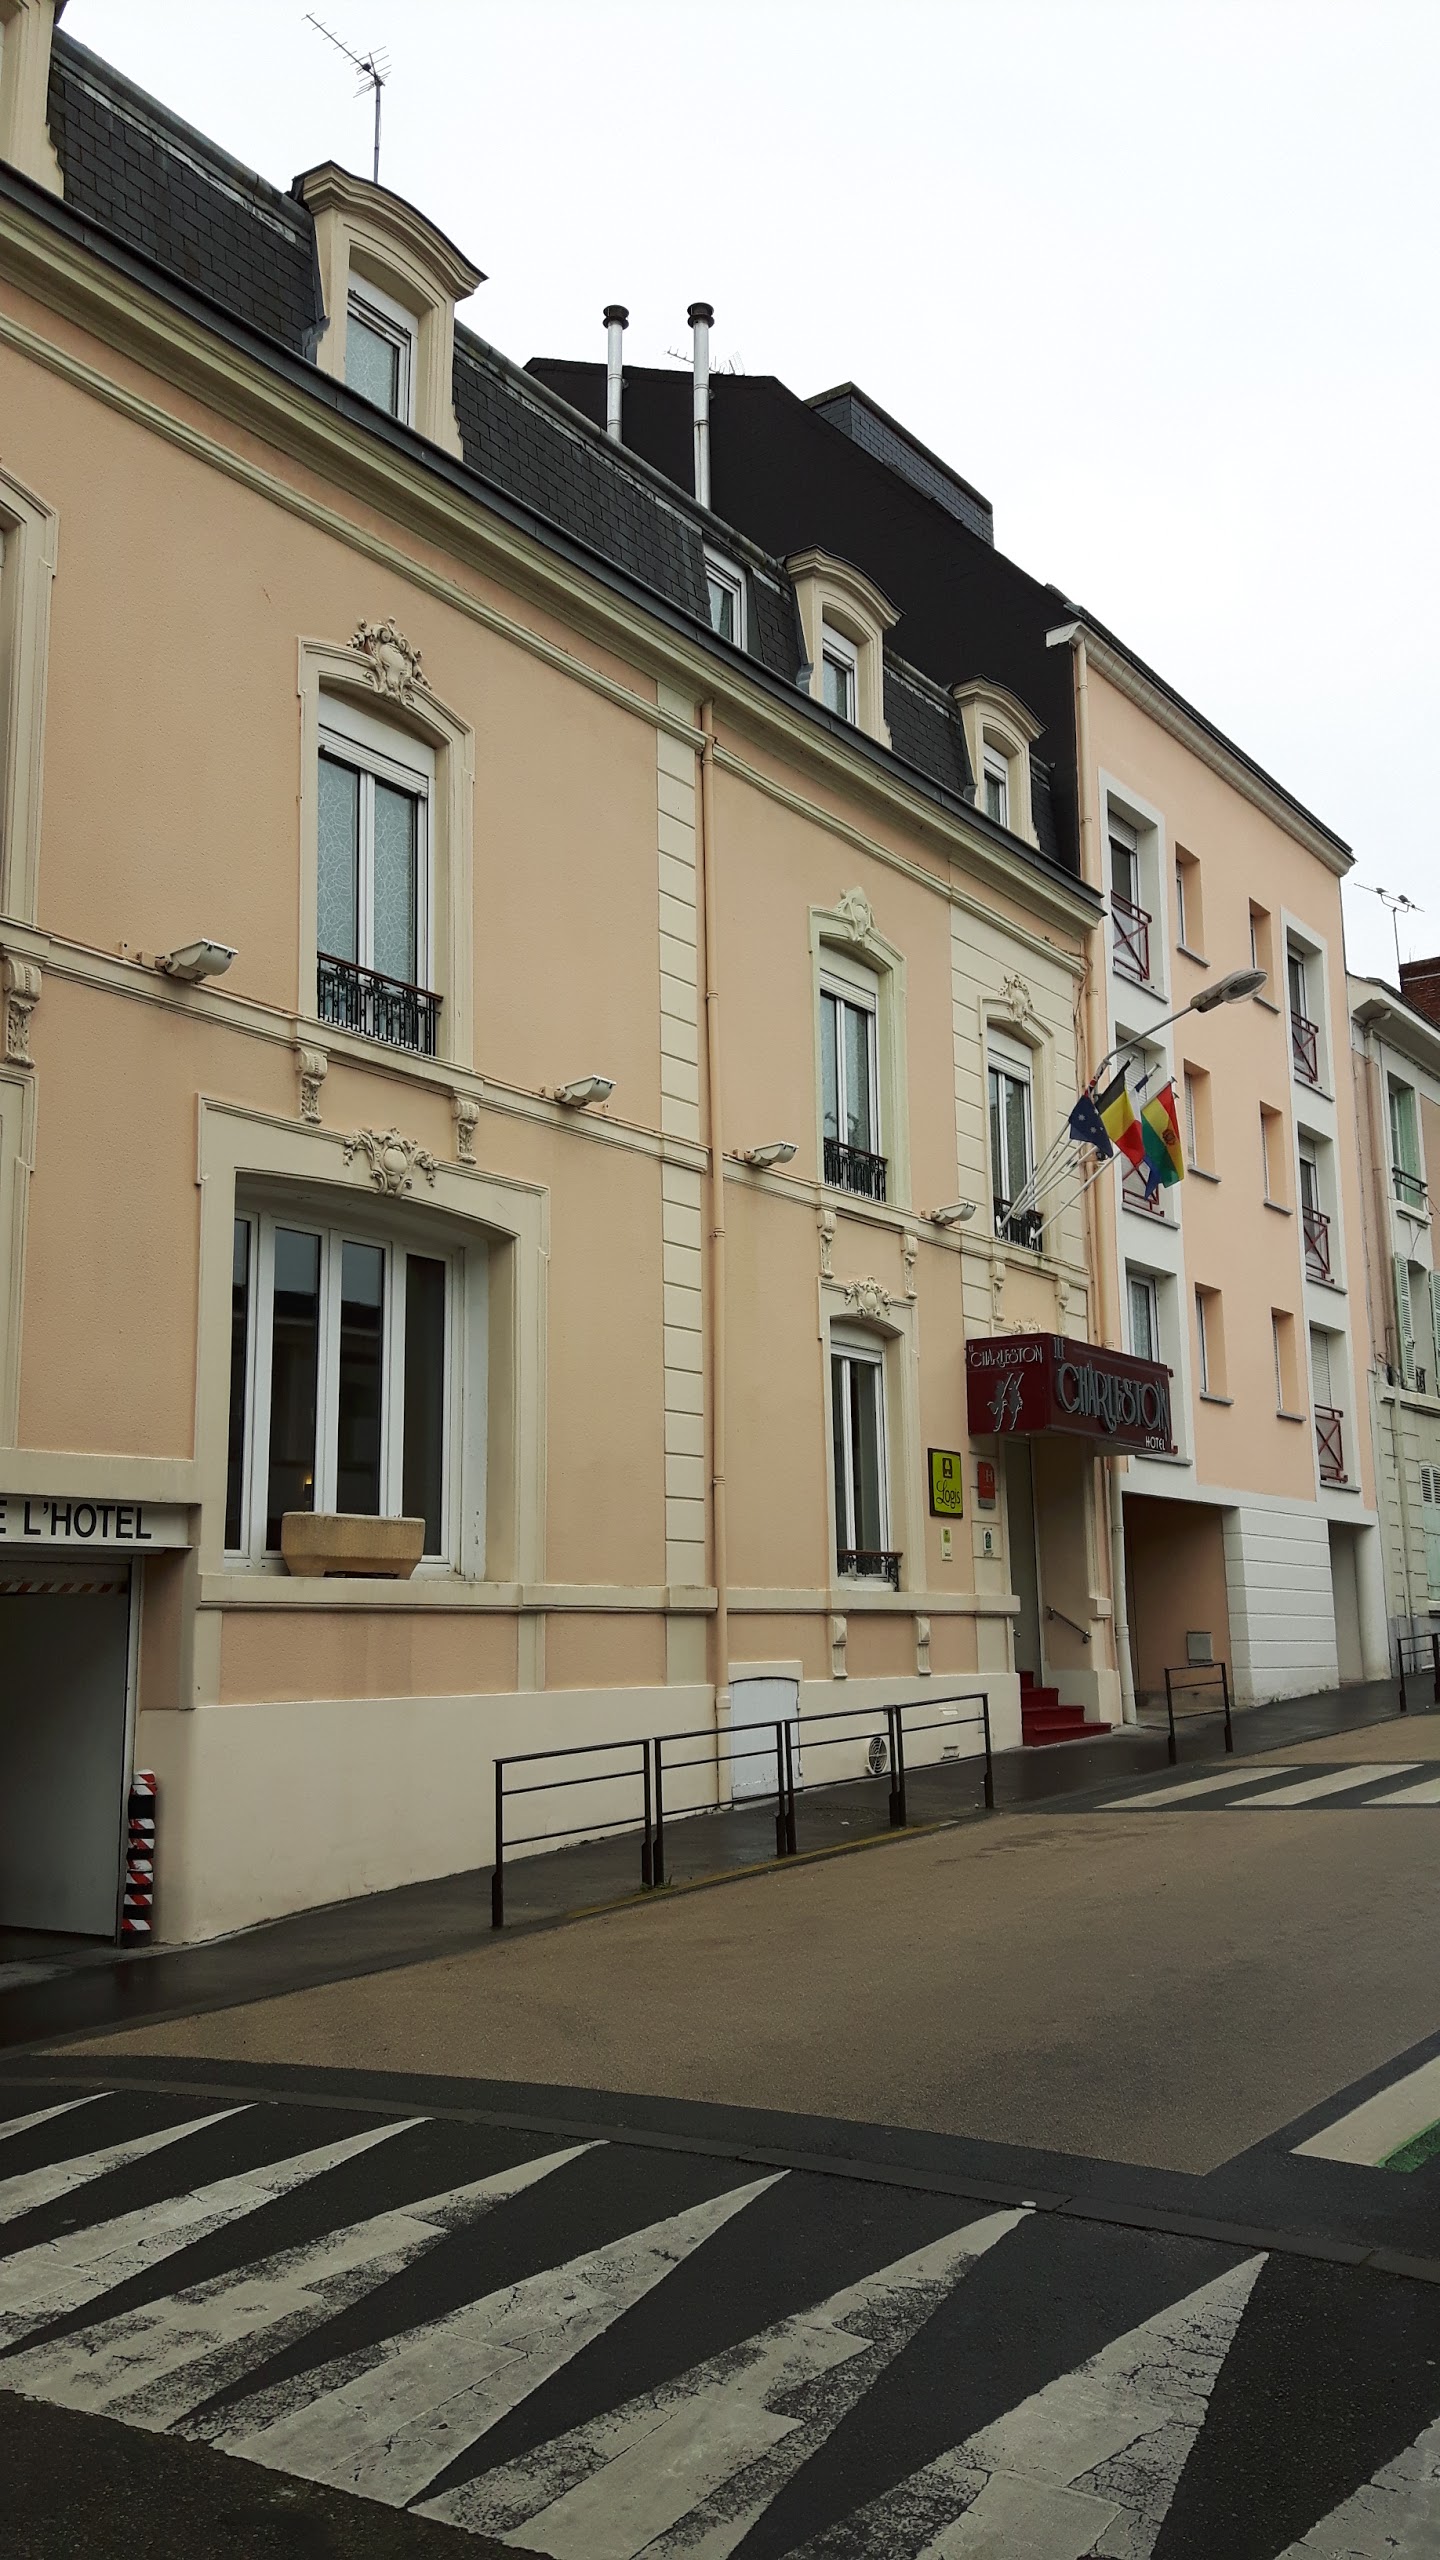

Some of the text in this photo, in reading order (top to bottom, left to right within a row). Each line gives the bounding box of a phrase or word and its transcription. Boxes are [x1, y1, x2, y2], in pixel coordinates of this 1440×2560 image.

[970, 1344, 1043, 1368] CHARLESTON
[1058, 1360, 1169, 1437] CHARLESTON
[1145, 1435, 1166, 1451] HOTEL
[936, 1480, 961, 1510] Logis
[24, 1501, 152, 1539] L'HOTEL
